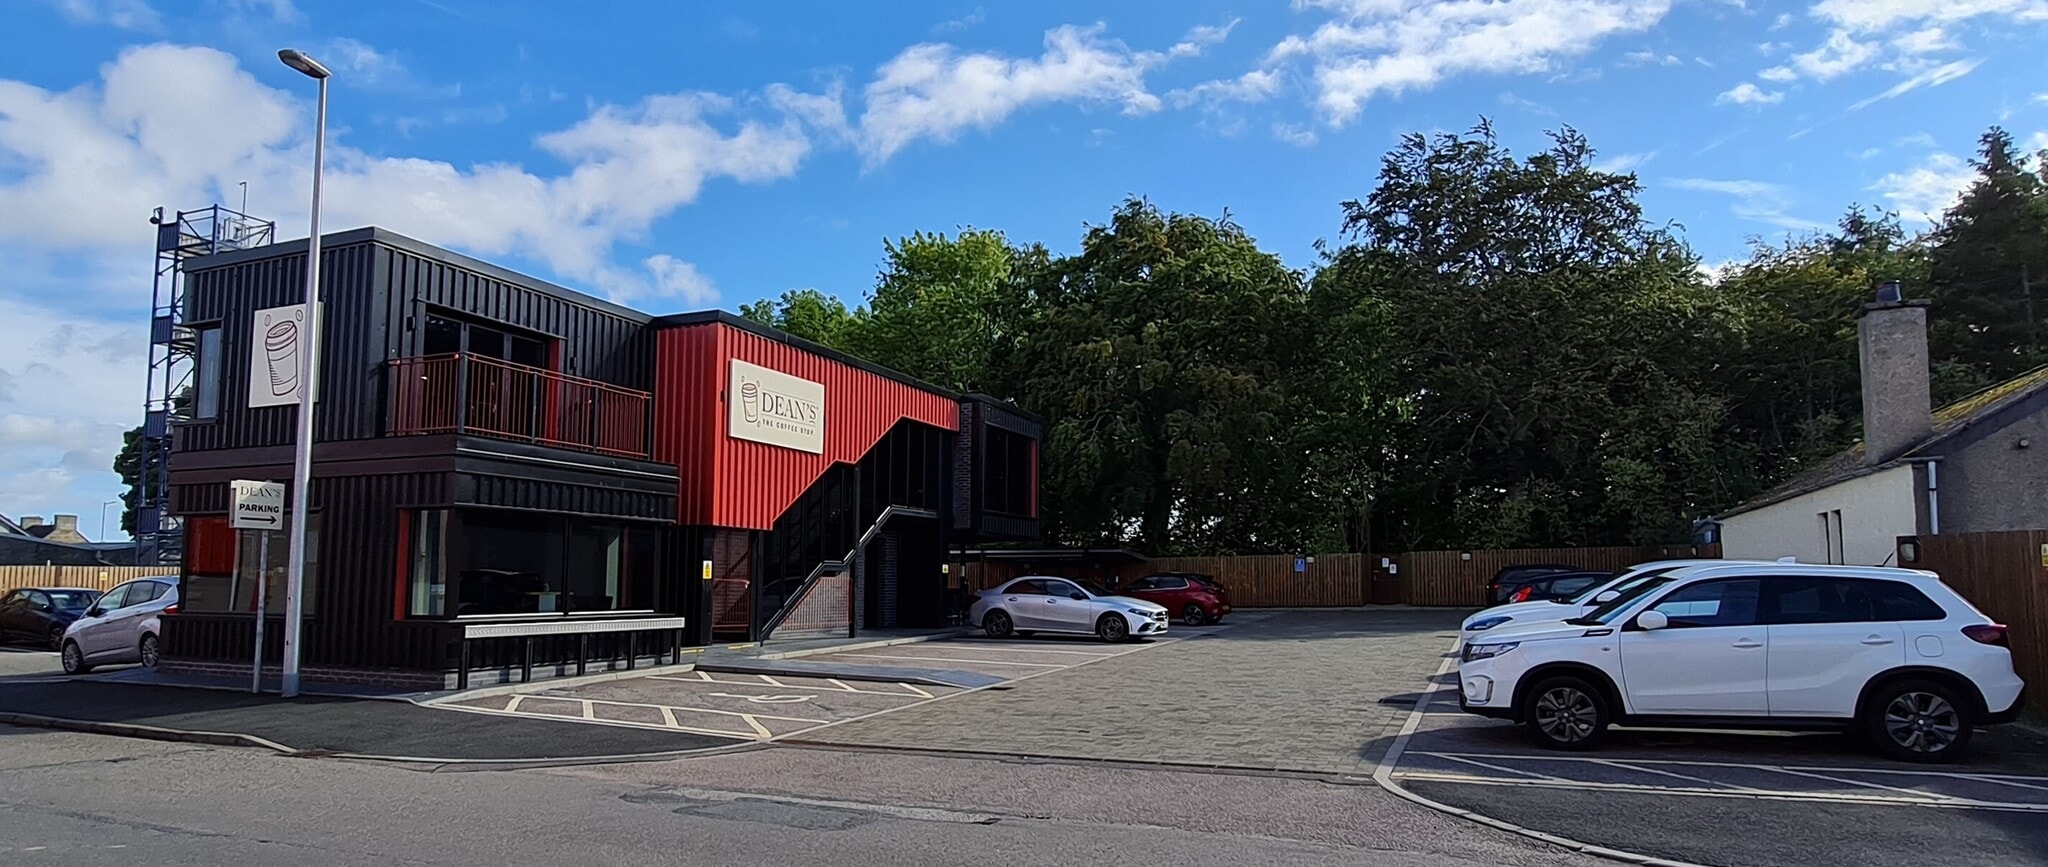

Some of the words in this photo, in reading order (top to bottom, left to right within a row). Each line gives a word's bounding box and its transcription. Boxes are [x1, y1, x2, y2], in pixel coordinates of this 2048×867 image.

[762, 391, 817, 422] DEAN'S
[762, 418, 774, 428] THE
[776, 421, 798, 433] COFFEE
[239, 503, 280, 513] PARKING
